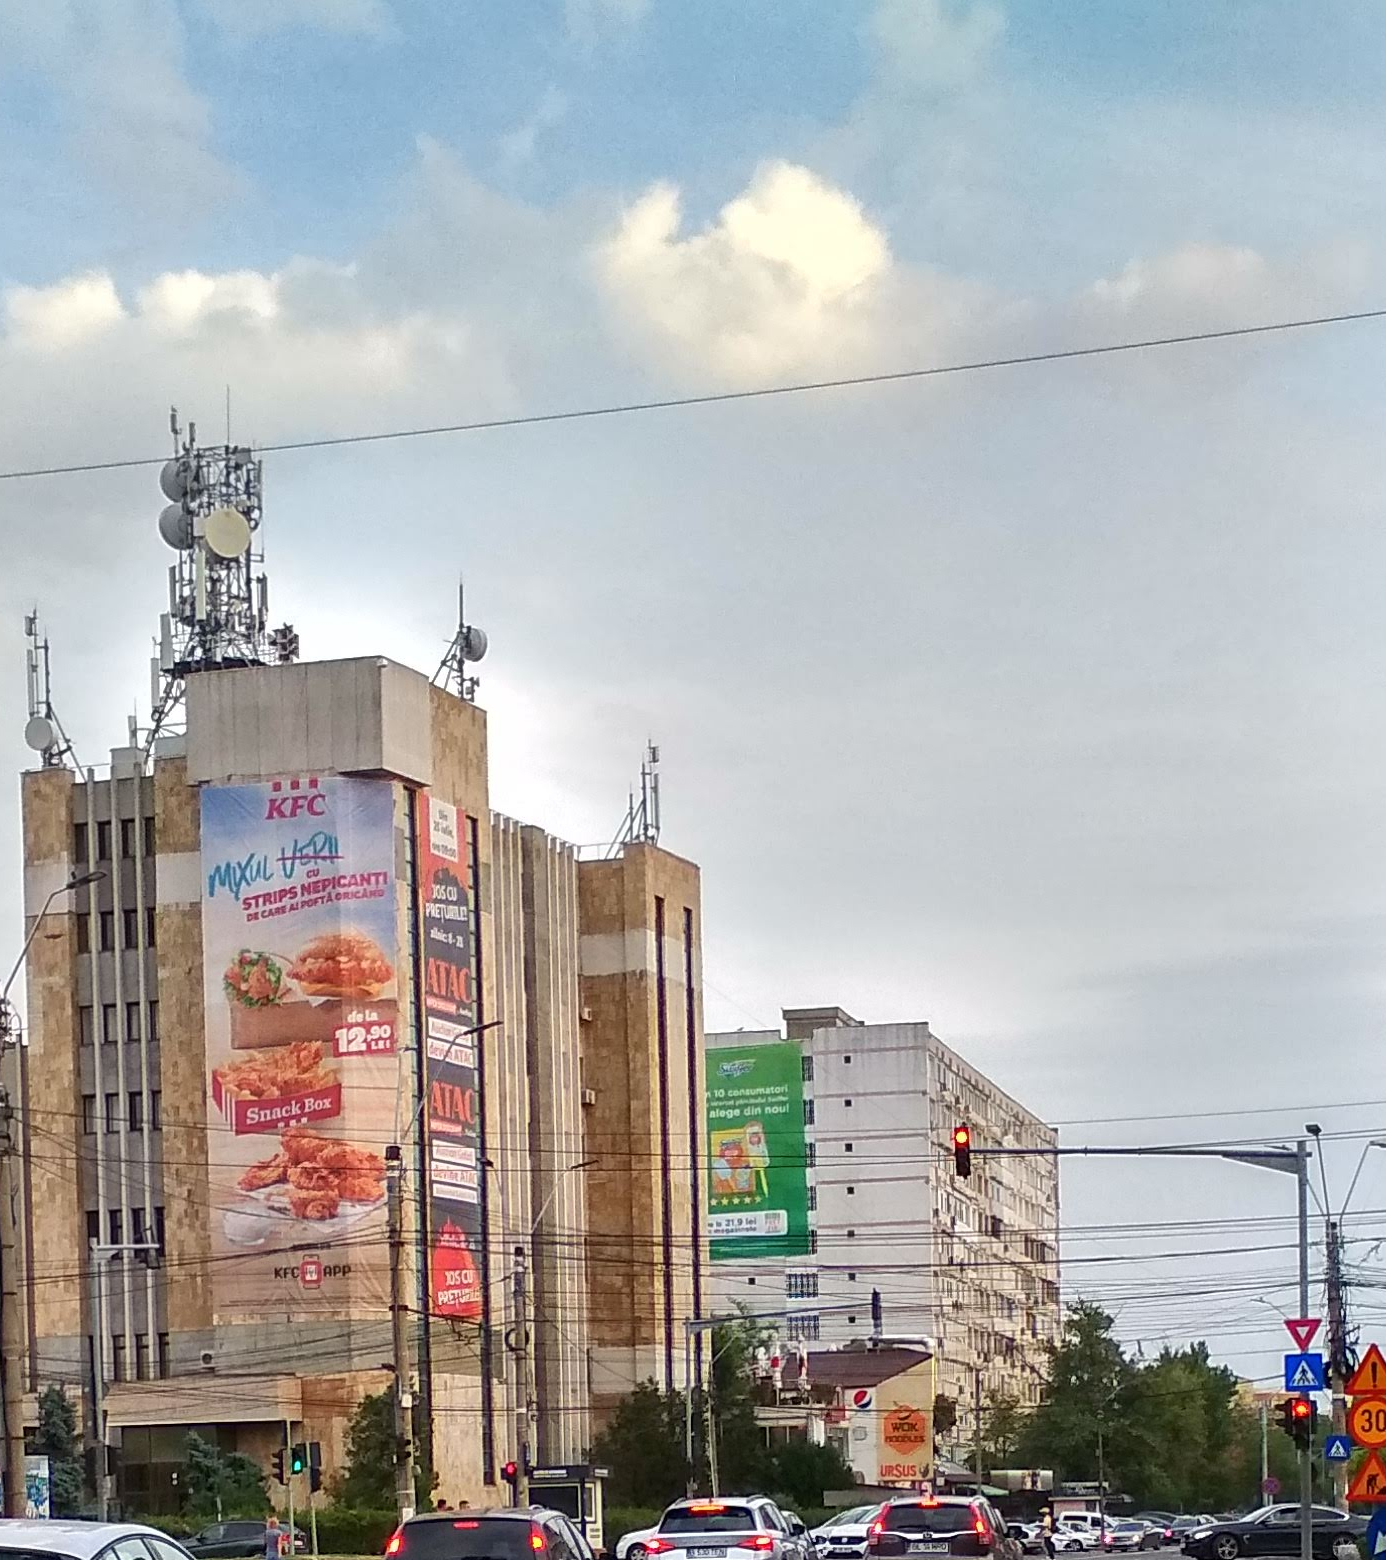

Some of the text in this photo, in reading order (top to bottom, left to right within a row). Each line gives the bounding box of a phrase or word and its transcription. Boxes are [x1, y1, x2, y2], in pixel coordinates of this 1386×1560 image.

[266, 794, 326, 820] KFC
[209, 853, 274, 901] MIXUL
[306, 868, 320, 879] CU
[242, 886, 298, 911] STRIPS
[246, 911, 259, 922] DE
[261, 906, 287, 919] CARE
[426, 957, 472, 1004] ATAC
[347, 1010, 363, 1023] de
[728, 1085, 788, 1097] consumatori
[430, 1080, 475, 1125] ATAC
[246, 1097, 331, 1125] Snack Box
[709, 1108, 740, 1119] alege
[743, 1106, 761, 1116] din
[274, 1265, 351, 1279] KFC APP
[891, 1422, 919, 1432] WOK
[880, 1464, 917, 1478] URSUS
